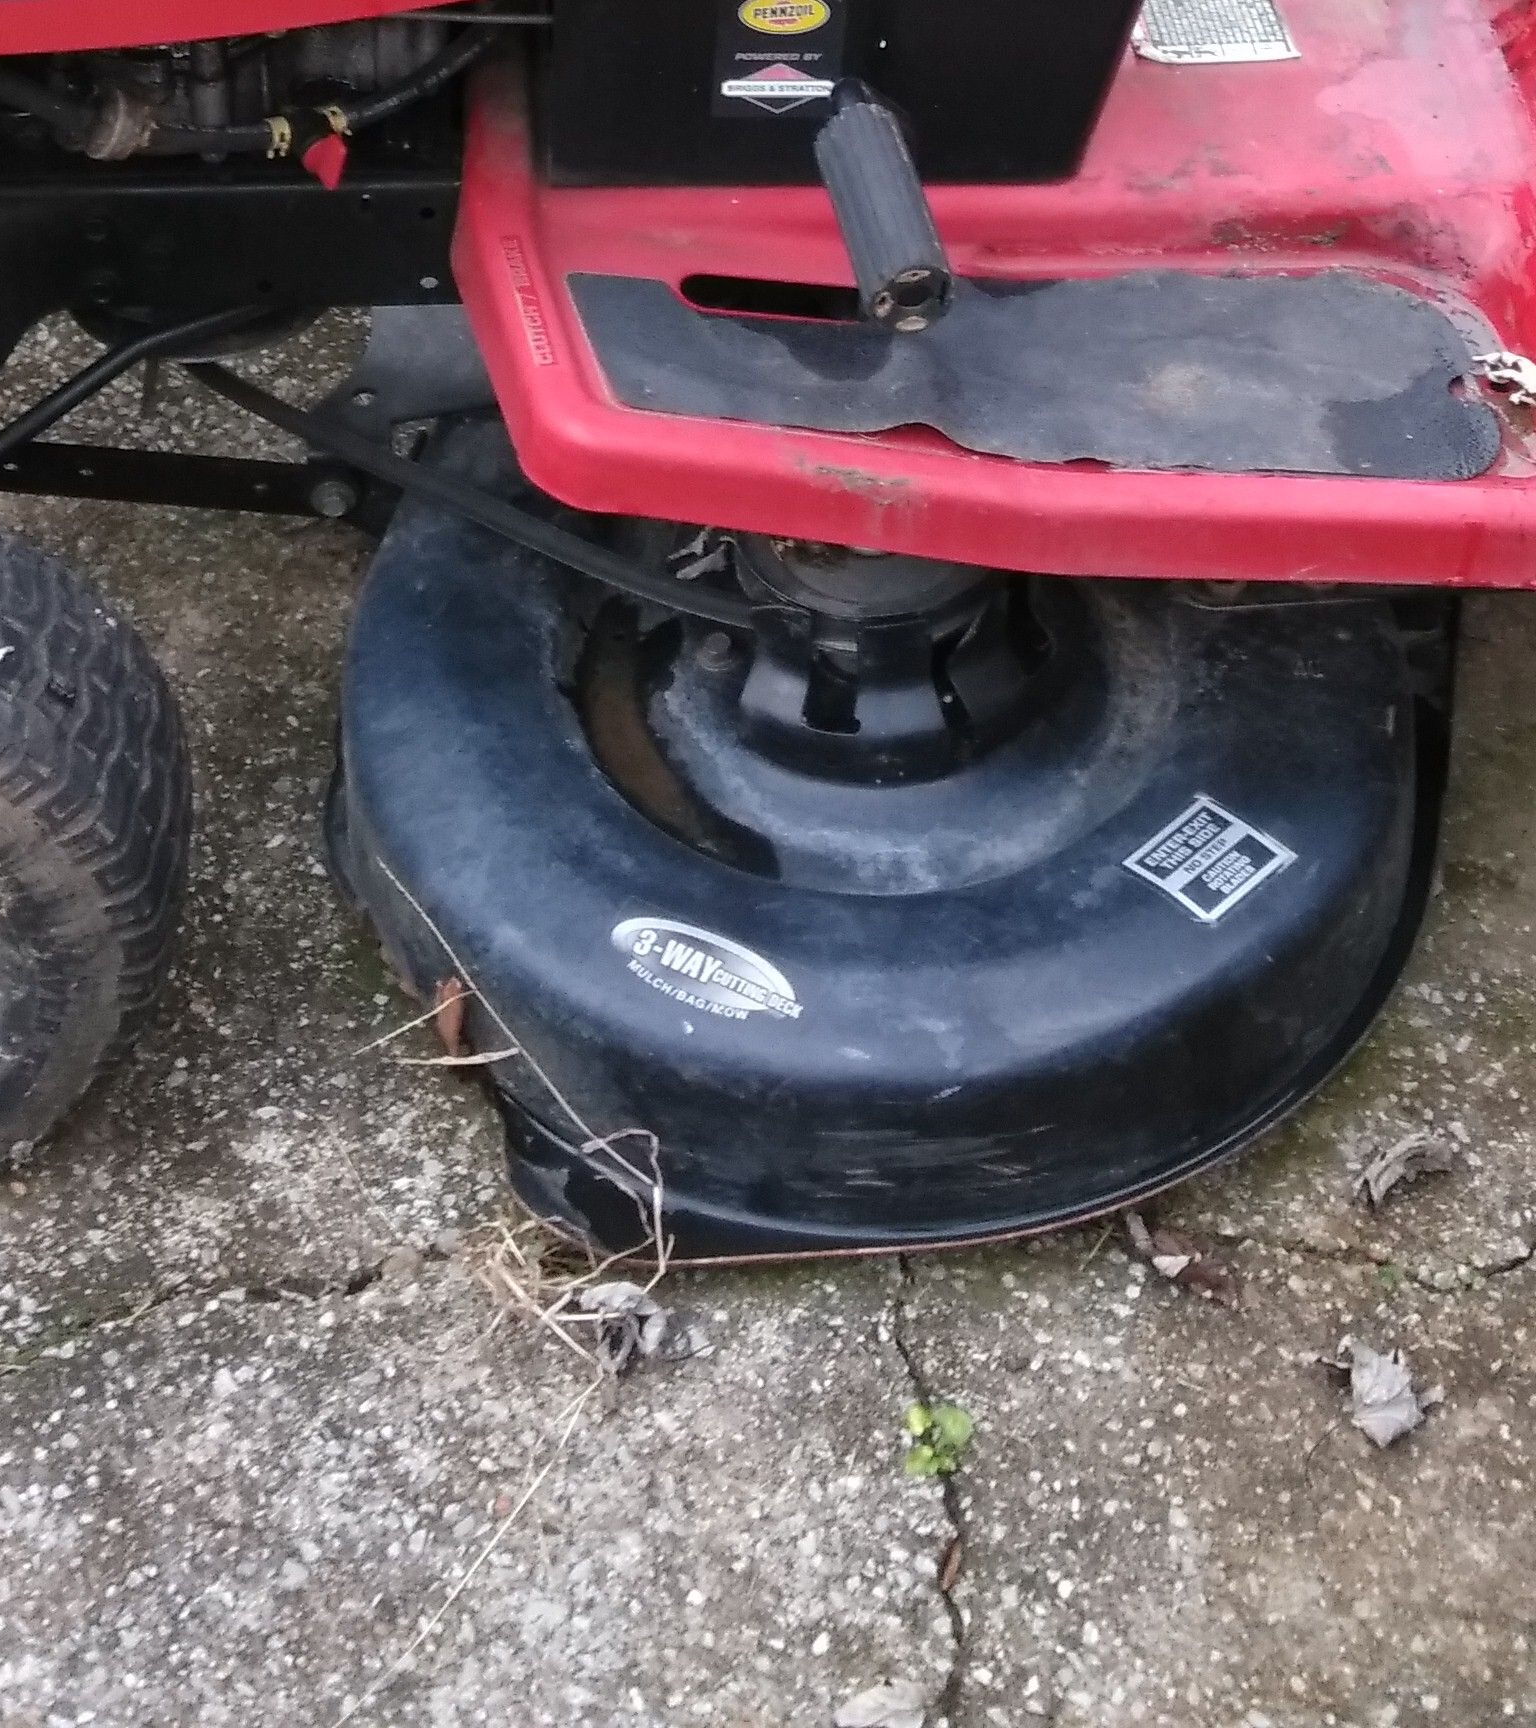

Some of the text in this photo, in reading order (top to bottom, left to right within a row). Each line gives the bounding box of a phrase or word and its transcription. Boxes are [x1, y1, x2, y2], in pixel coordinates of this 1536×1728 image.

[752, 3, 816, 19] PENNZOIL
[734, 52, 823, 62] POWERED BY
[727, 84, 766, 92] BRIGGS
[778, 84, 832, 92] STRATTON
[1159, 823, 1222, 871] THIS SIDE
[1183, 837, 1228, 875] NO STEP
[1201, 850, 1241, 884] CAUTION
[626, 958, 750, 1020] MULCH/BAG/MOW
[633, 929, 804, 1019] 3-WAY CUTTING DECK
